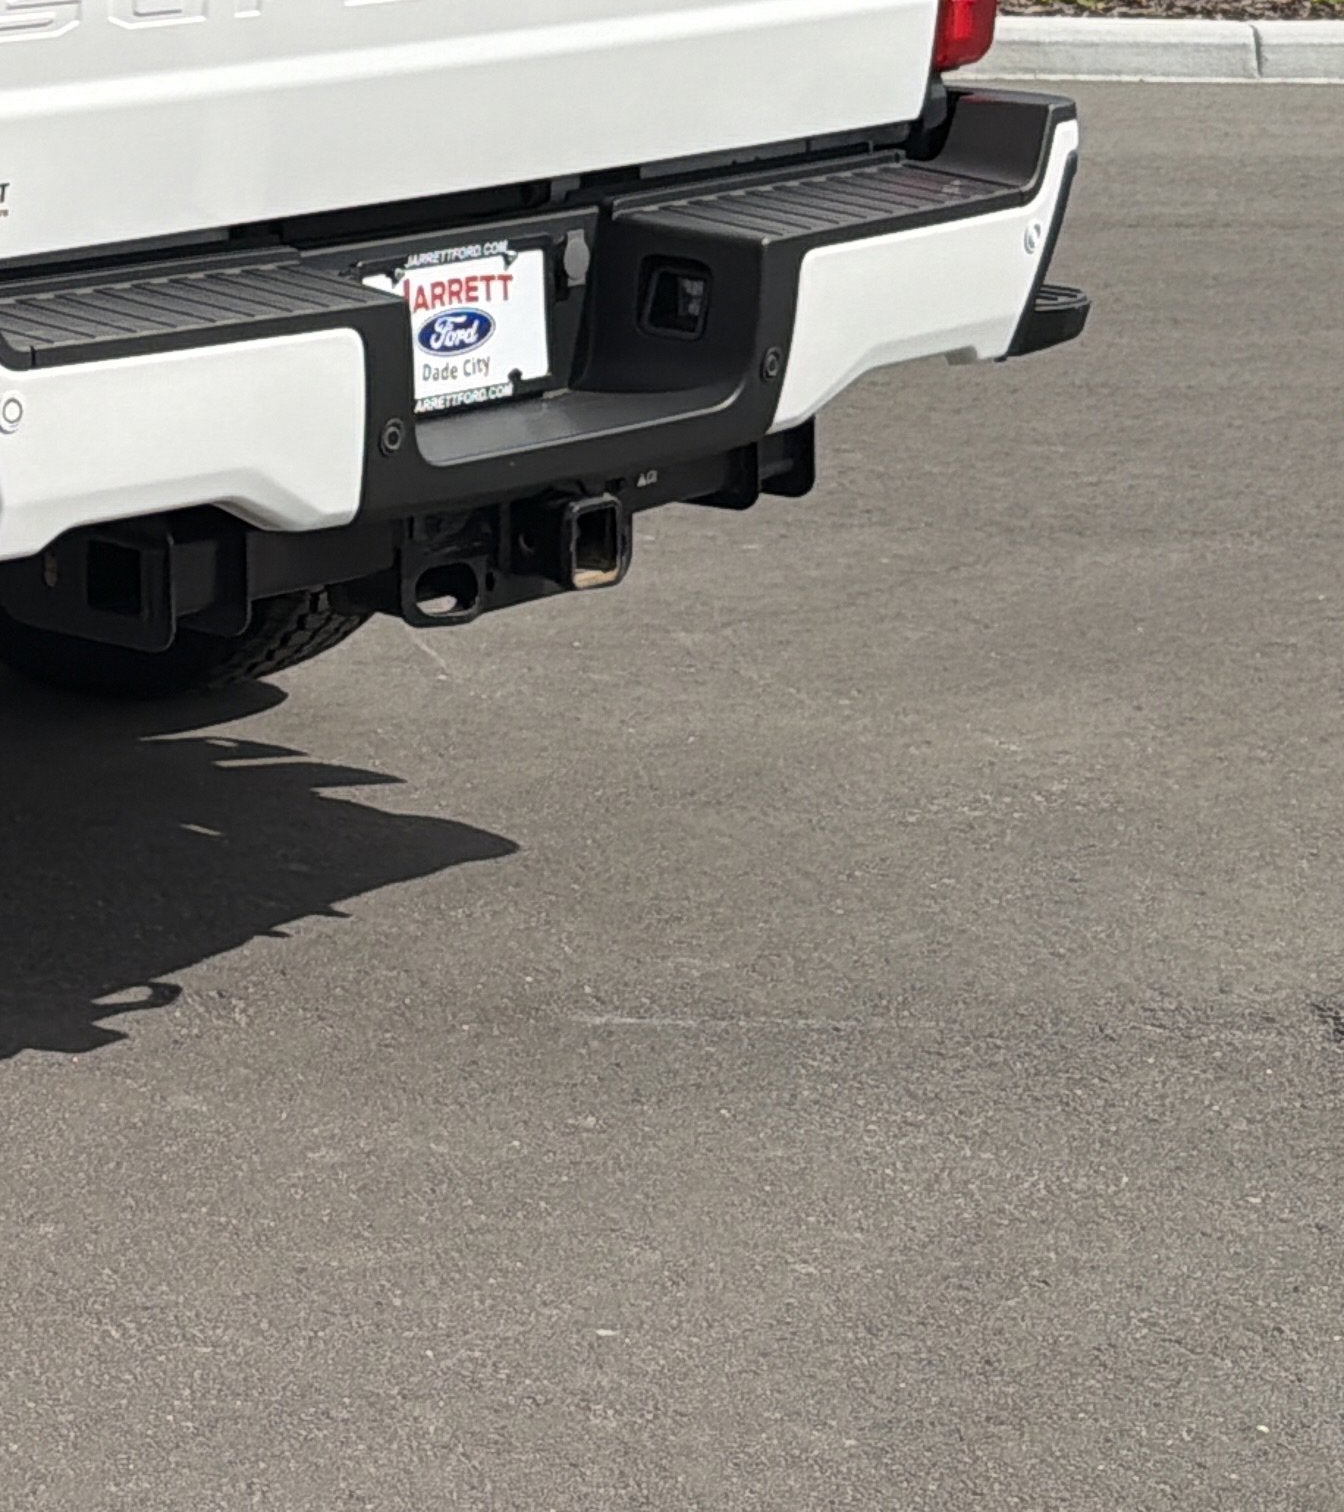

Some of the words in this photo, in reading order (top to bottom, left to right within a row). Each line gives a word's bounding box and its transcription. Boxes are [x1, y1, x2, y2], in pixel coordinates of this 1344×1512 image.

[430, 315, 480, 350] Ford
[422, 362, 459, 382] Dade
[463, 356, 491, 377] City
[413, 382, 514, 414] ARRETTFORD.COM
